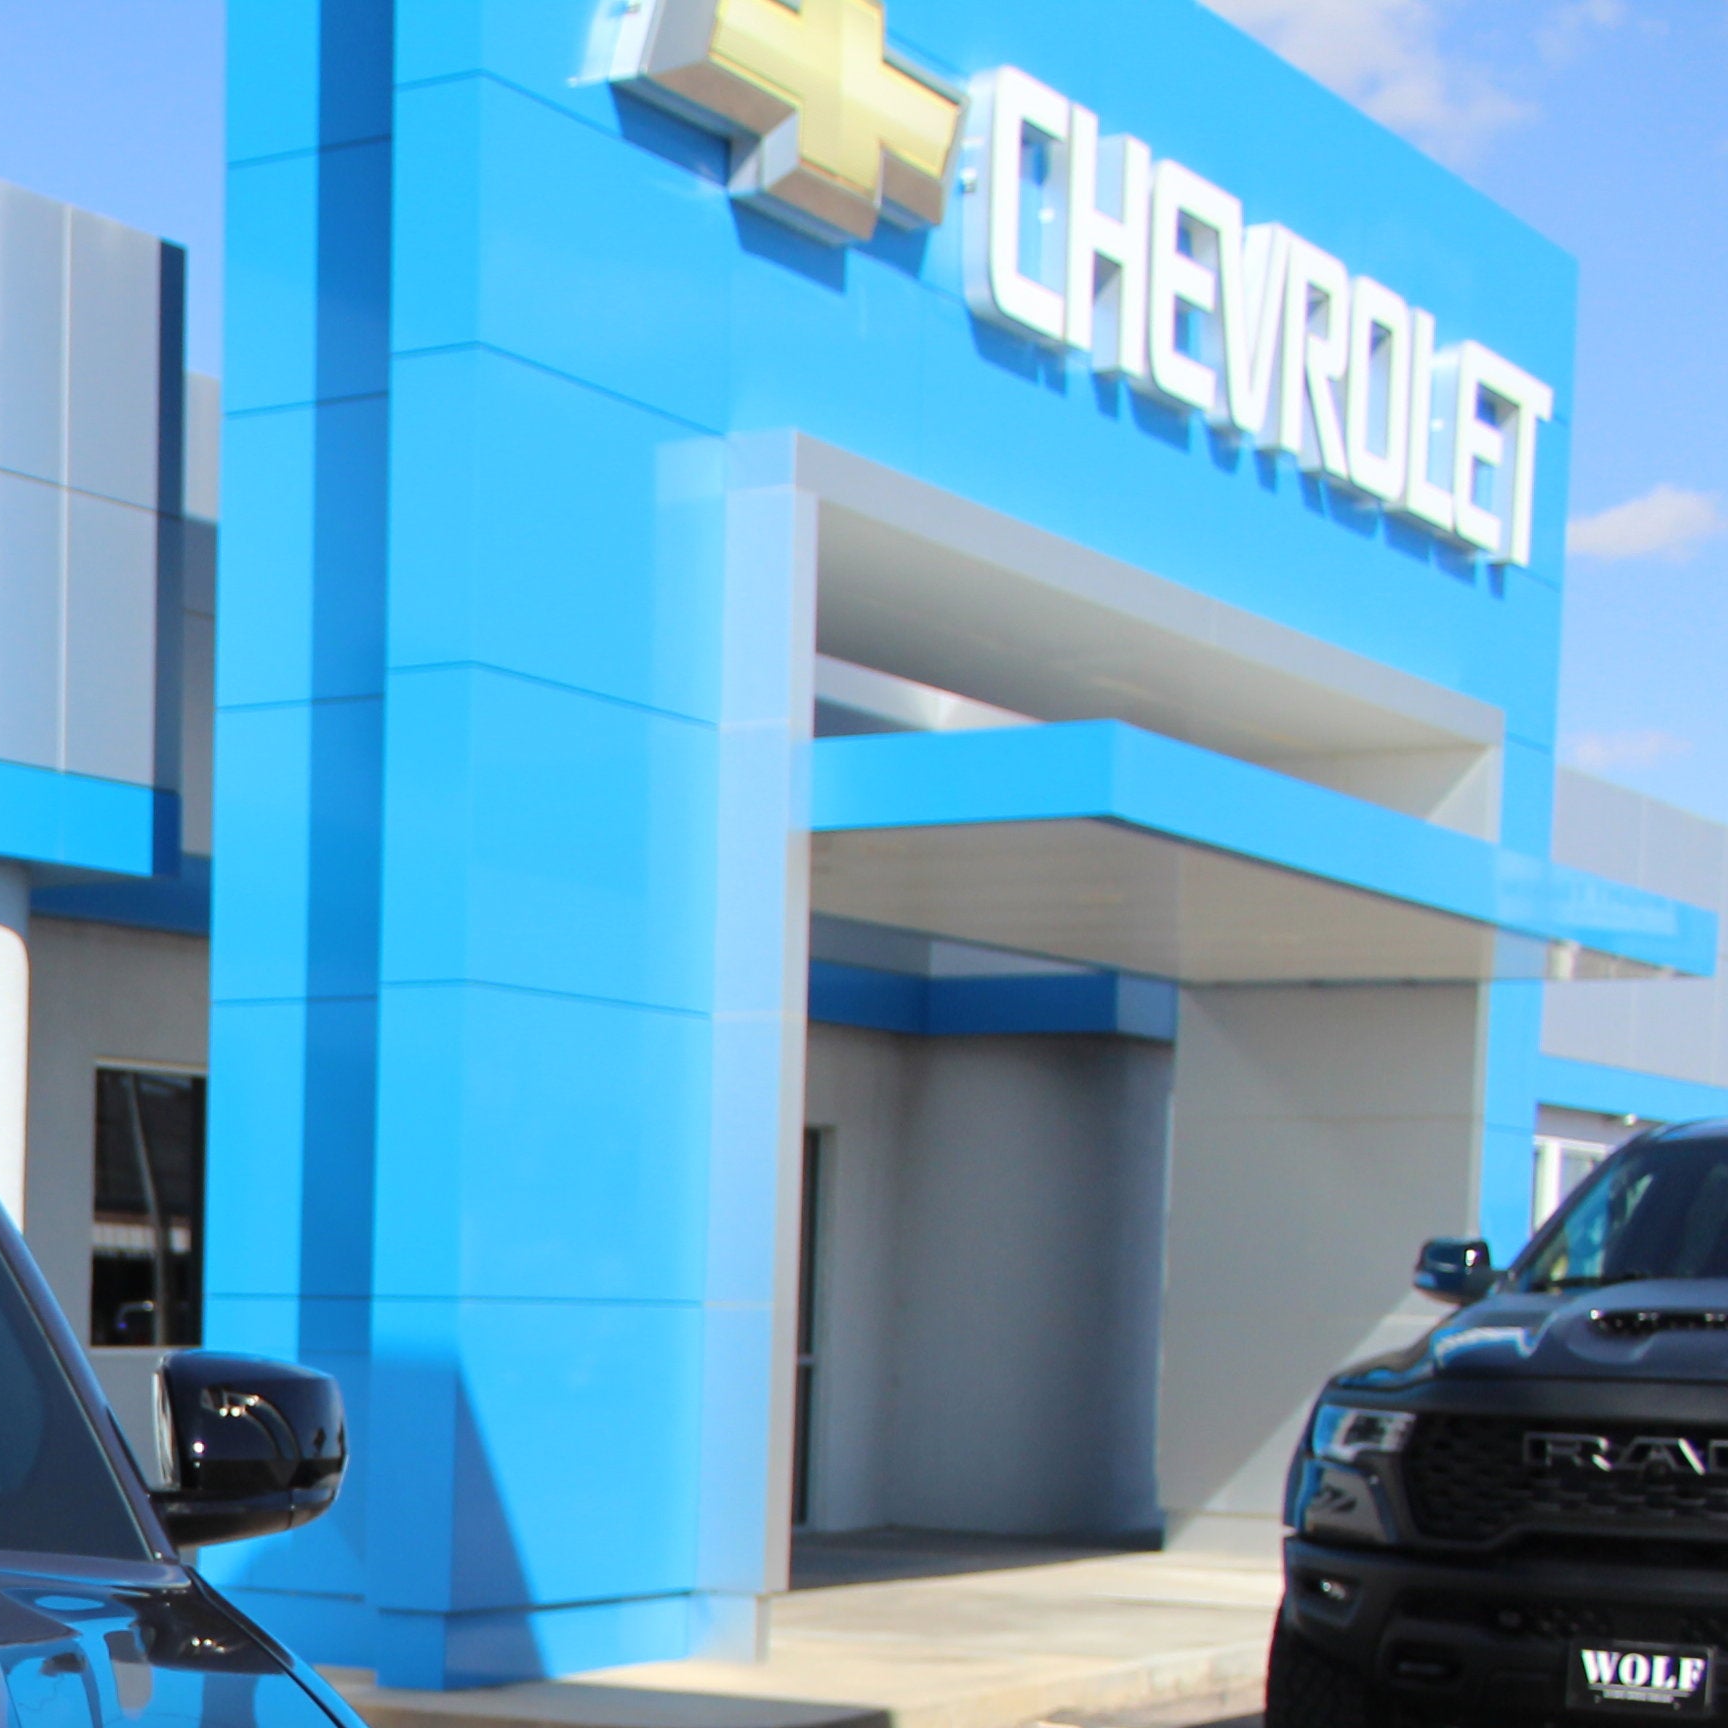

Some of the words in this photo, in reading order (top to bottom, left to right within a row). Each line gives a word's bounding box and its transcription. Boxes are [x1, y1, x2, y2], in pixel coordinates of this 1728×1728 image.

[968, 64, 1554, 568] CHEVROLET
[1523, 1431, 1728, 1476] RA
[1580, 1649, 1707, 1692] WOLF
